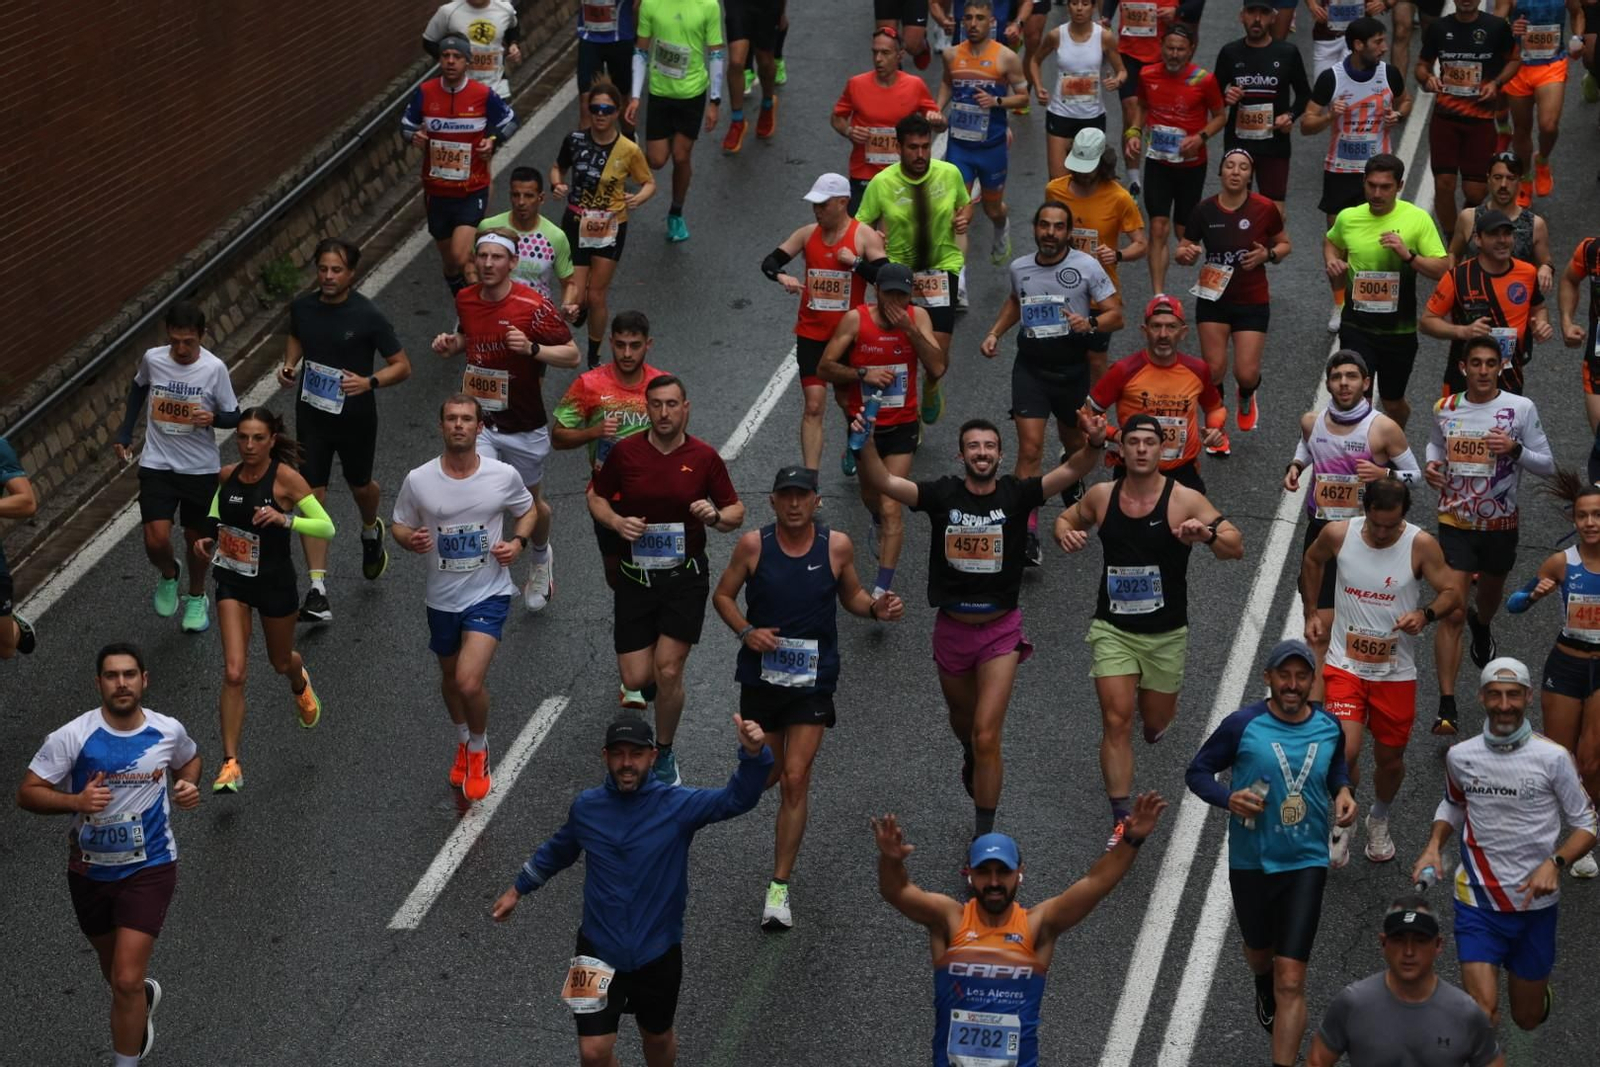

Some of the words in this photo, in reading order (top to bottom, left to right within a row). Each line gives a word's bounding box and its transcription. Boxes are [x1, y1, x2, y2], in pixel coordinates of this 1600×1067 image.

[471, 54, 493, 66] 905
[435, 150, 461, 162] 3784
[812, 279, 841, 294] 4488
[1359, 281, 1388, 295] 5004
[1026, 305, 1054, 322] 3151
[310, 373, 337, 393] 2017
[469, 376, 498, 393] 4808
[157, 400, 190, 418] 4086
[1452, 440, 1485, 457] 4505
[1320, 485, 1354, 501] 4627
[442, 536, 477, 553] 3074
[640, 535, 672, 550] 3064
[953, 537, 990, 553] 4573
[1114, 577, 1149, 594] 2923
[1343, 586, 1395, 602] UNLEASH
[1350, 638, 1386, 657] 4562
[772, 650, 806, 668] 1598
[1464, 783, 1518, 797] MARATÓN
[89, 826, 129, 846] 2709
[948, 962, 1034, 980] CAPA
[967, 986, 987, 997] Los
[989, 988, 1025, 1000] Alcores
[958, 1026, 1004, 1049] 2782
